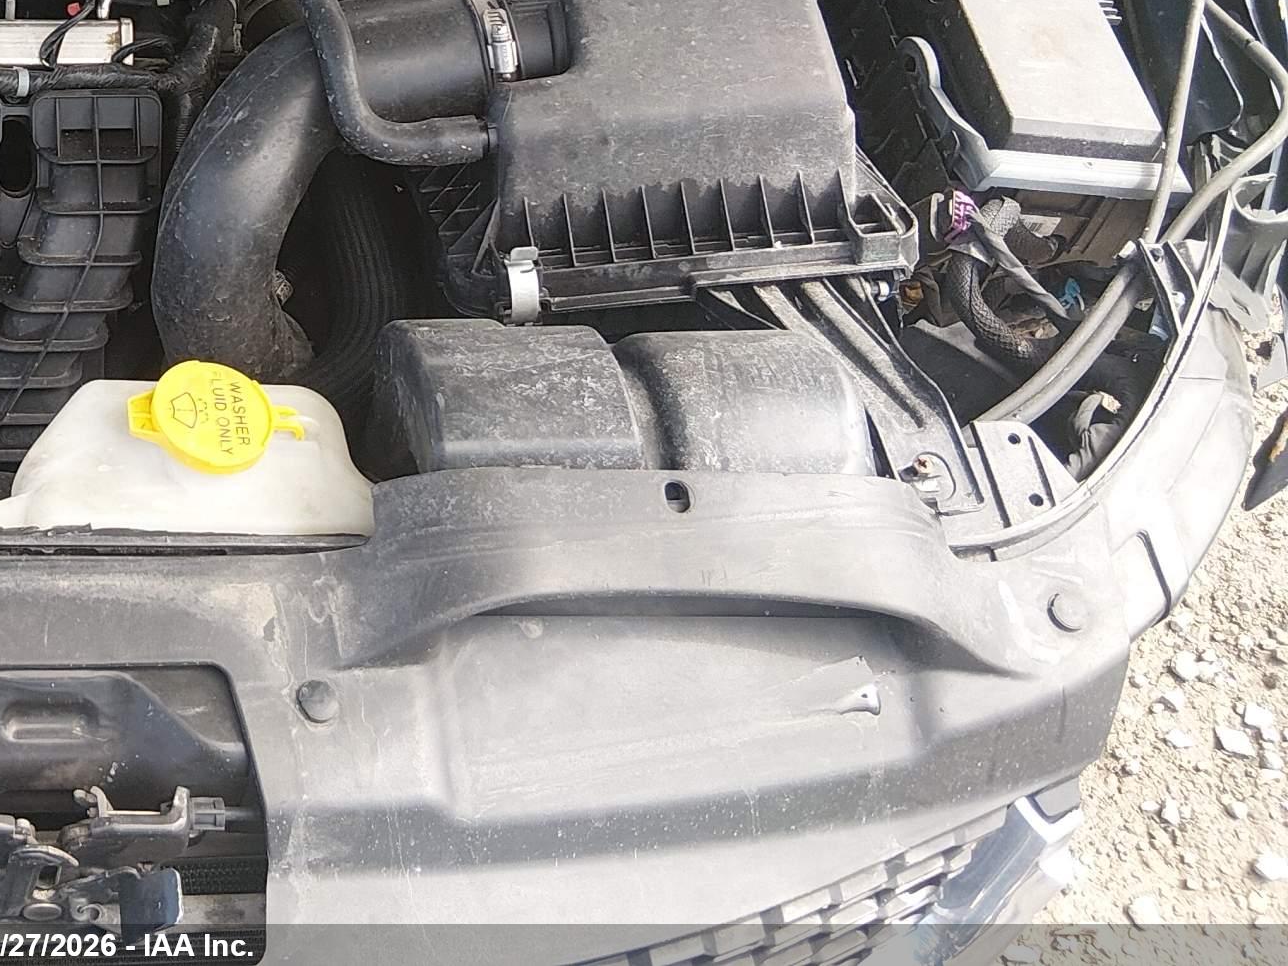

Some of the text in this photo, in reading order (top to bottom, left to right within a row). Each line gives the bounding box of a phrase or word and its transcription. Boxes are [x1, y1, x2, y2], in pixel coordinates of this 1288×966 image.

[211, 371, 234, 455] FLUID ONLY
[229, 381, 251, 446] WASHER
